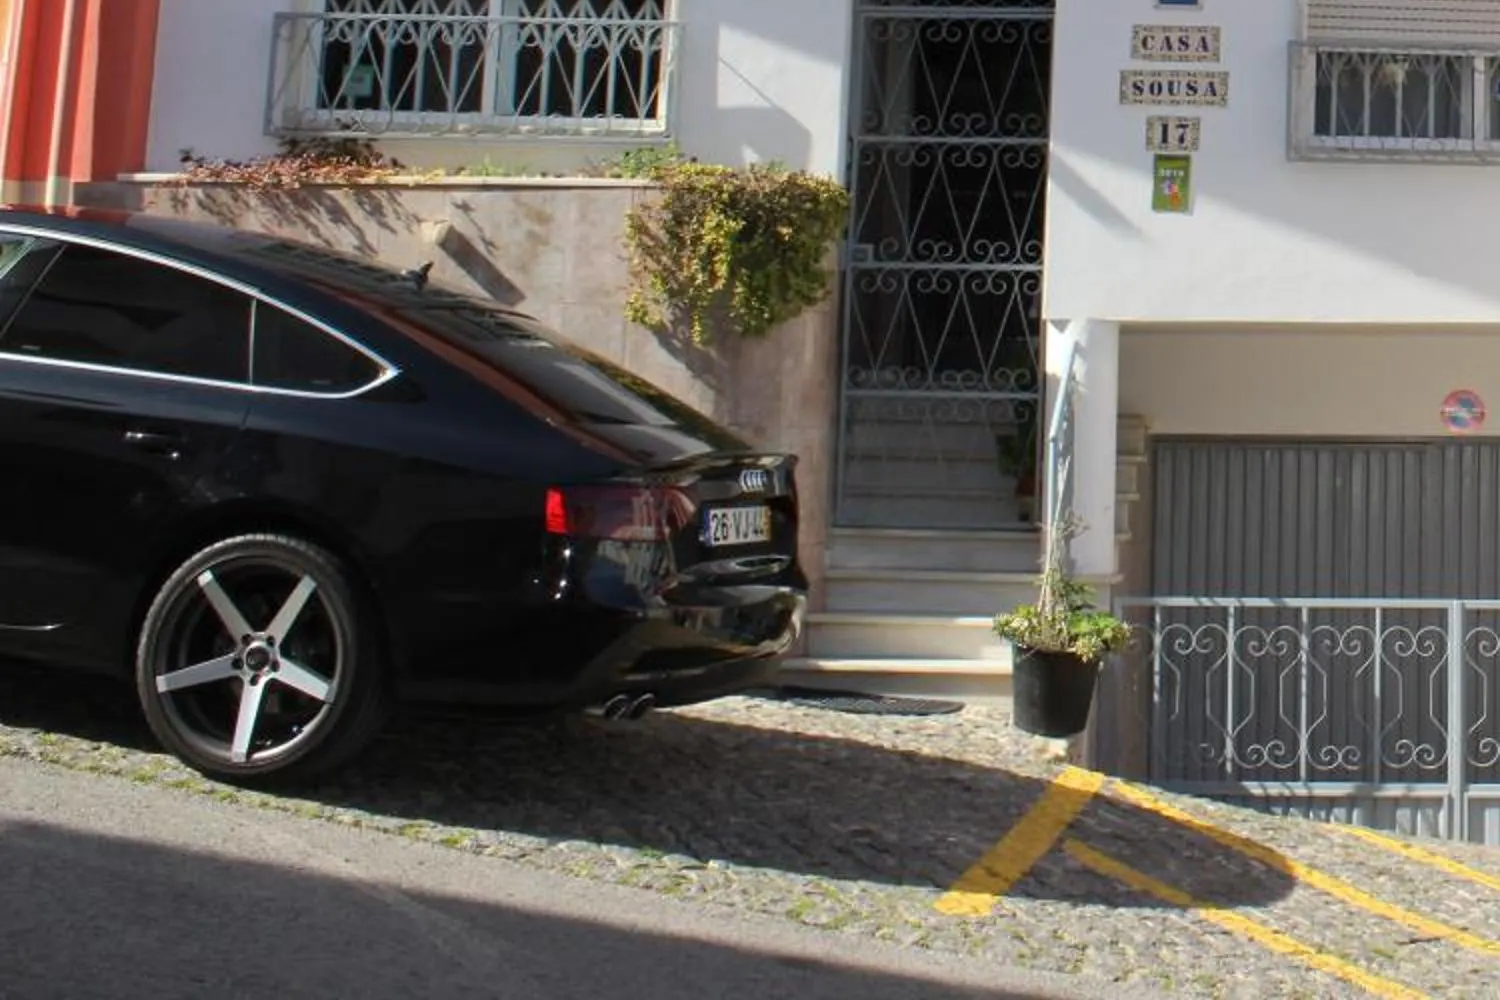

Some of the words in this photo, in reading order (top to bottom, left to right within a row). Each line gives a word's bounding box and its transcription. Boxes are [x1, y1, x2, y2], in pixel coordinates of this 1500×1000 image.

[1141, 34, 1209, 52] CASA
[1132, 79, 1217, 97] SOUSA
[1161, 122, 1189, 144] 17
